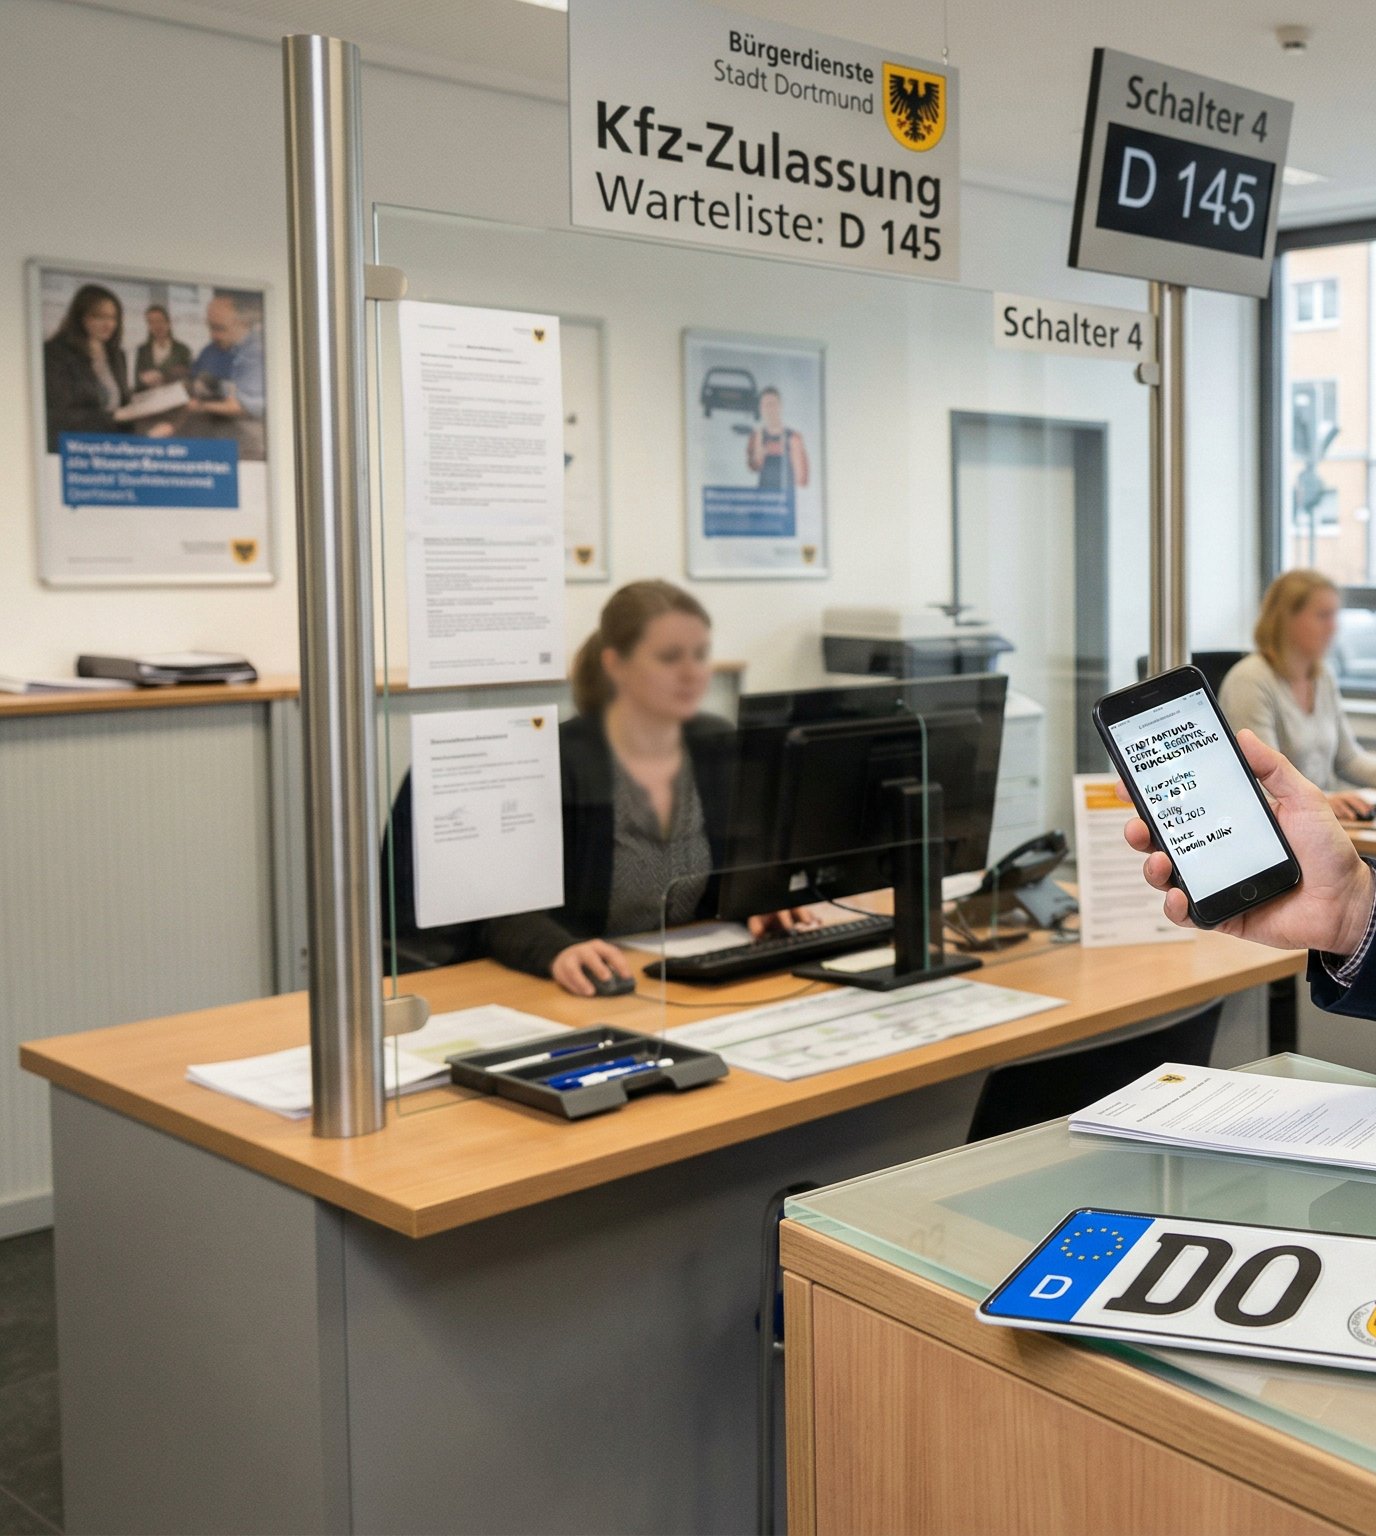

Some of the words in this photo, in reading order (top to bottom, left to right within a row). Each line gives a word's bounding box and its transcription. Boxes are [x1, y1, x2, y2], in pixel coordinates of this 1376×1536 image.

[714, 58, 768, 93] Stadt
[774, 72, 874, 115] Dortmund
[729, 30, 875, 85] Bürgerdienste
[1126, 75, 1245, 136] Schalter
[1251, 110, 1268, 143] 4
[597, 100, 941, 219] Kfz-Zulassung
[1117, 146, 1158, 209] D
[1177, 160, 1258, 231] 145
[595, 171, 824, 245] Warteliste:
[839, 211, 866, 249] D
[881, 219, 942, 262] 145
[1004, 306, 1120, 349] Schalter
[1127, 321, 1143, 351] 4
[1029, 1274, 1073, 1300] D
[1103, 1232, 1322, 1327] DO
